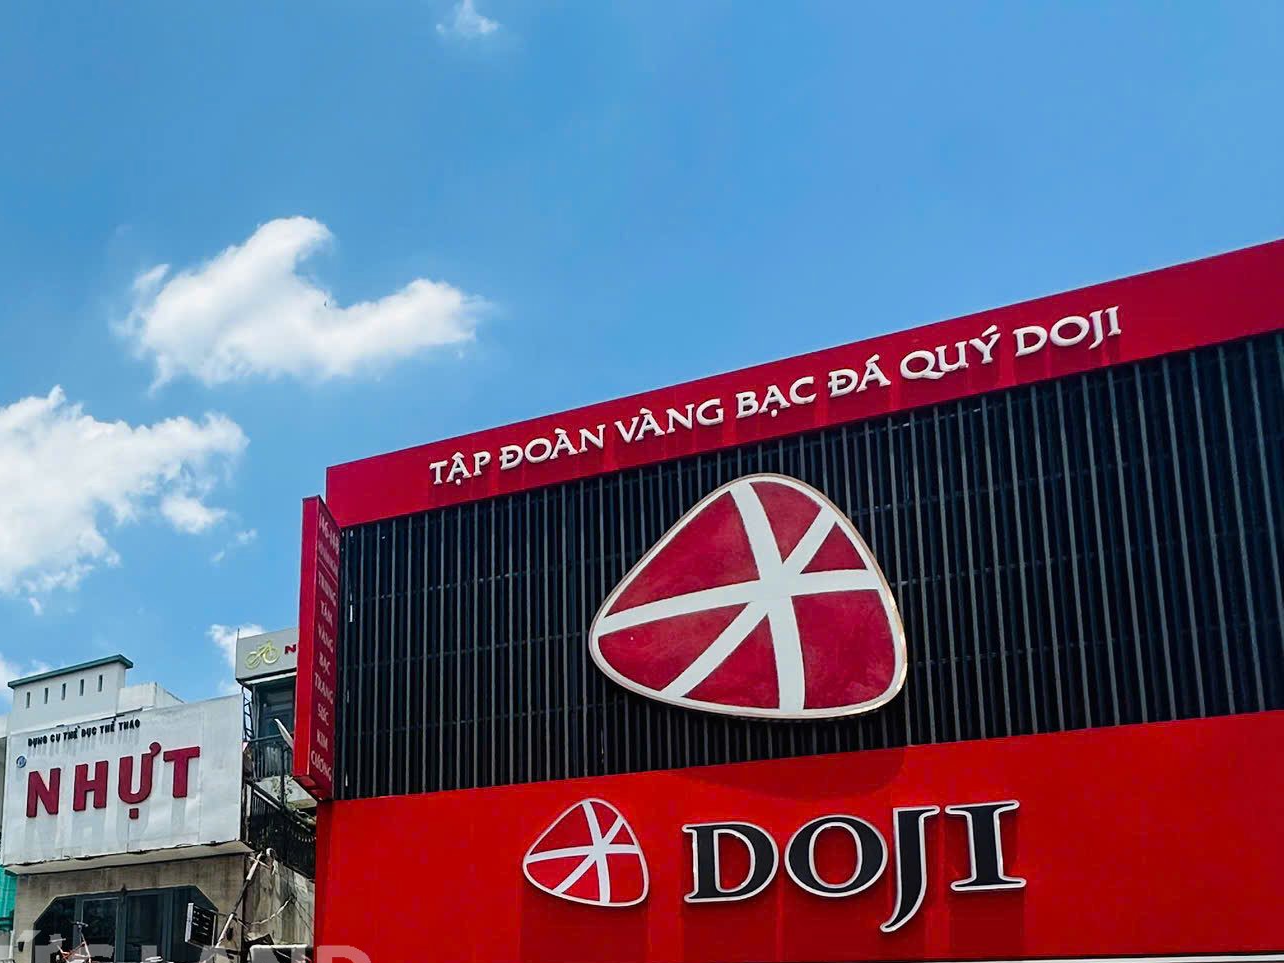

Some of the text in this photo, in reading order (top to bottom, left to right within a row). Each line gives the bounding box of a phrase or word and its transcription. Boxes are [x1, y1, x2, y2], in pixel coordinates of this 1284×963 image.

[429, 305, 1122, 486] TẬP ĐOÀN VÀNG BẠC ĐÁ QUÝ DOJI
[318, 652, 332, 676] BẠC
[315, 671, 334, 705] TRANG
[81, 726, 97, 738] DỤC
[118, 718, 140, 731] THAO
[317, 703, 330, 726] SỨC
[316, 729, 329, 750] KIM
[26, 741, 201, 819] NHỰT
[311, 750, 332, 782] CƯƠNG
[681, 799, 1027, 933] DOJI
